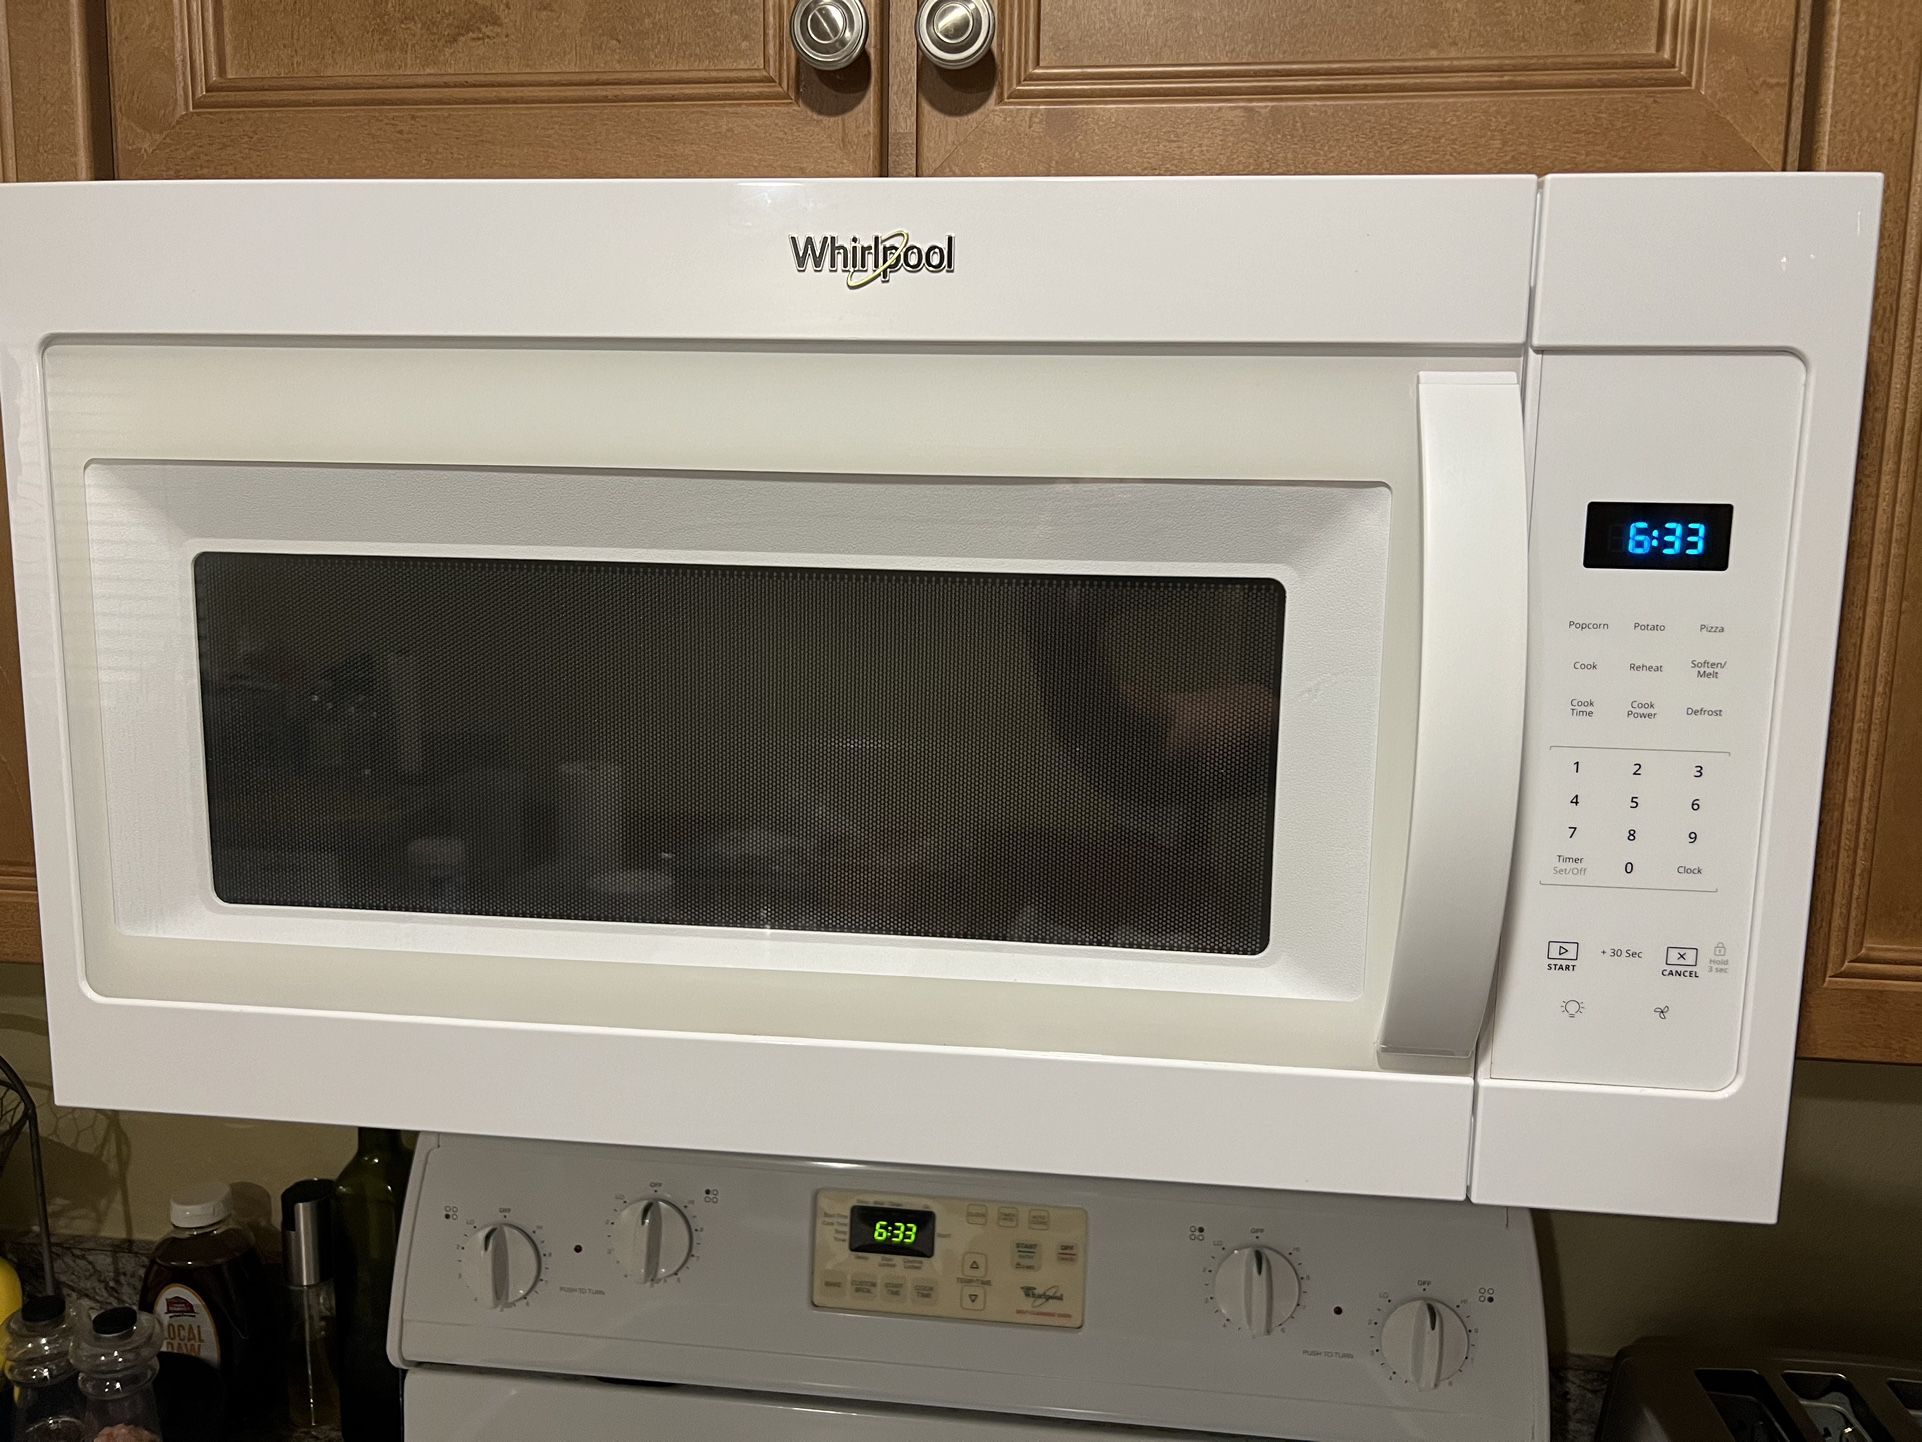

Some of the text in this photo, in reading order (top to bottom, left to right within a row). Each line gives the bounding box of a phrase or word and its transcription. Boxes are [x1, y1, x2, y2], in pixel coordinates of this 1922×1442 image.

[790, 232, 955, 286] Whirlpool
[1628, 521, 1706, 555] 6:33
[1568, 621, 1609, 632] Popcorn
[1633, 622, 1666, 632] Potato
[1699, 624, 1725, 633] Pizza
[1573, 661, 1598, 671] Cook
[1629, 662, 1663, 673] Reheat
[1690, 660, 1727, 671] Soften/
[1697, 669, 1719, 679] Melt
[1570, 698, 1595, 709] Cook
[1630, 700, 1655, 710] Cook
[1570, 708, 1594, 718] Time
[1626, 709, 1657, 720] Power
[1686, 706, 1723, 717] Defrost
[1573, 760, 1580, 774] 1
[1632, 763, 1642, 776] 2
[1693, 765, 1704, 778] 3
[1569, 794, 1580, 807] 4
[1629, 796, 1639, 809] 5
[1690, 798, 1701, 812] 6
[1567, 826, 1578, 839] 7
[1627, 828, 1637, 842] 8
[1688, 831, 1698, 844] 9
[1556, 854, 1584, 864] Timer
[1552, 866, 1588, 876] Set/Off
[1624, 861, 1634, 875] 0
[1676, 865, 1703, 875] Clock
[1609, 948, 1623, 958] 30
[1625, 948, 1643, 959] Sec
[1547, 963, 1577, 972] START
[1661, 968, 1700, 978] CANCEL
[874, 1221, 917, 1243] 6:33
